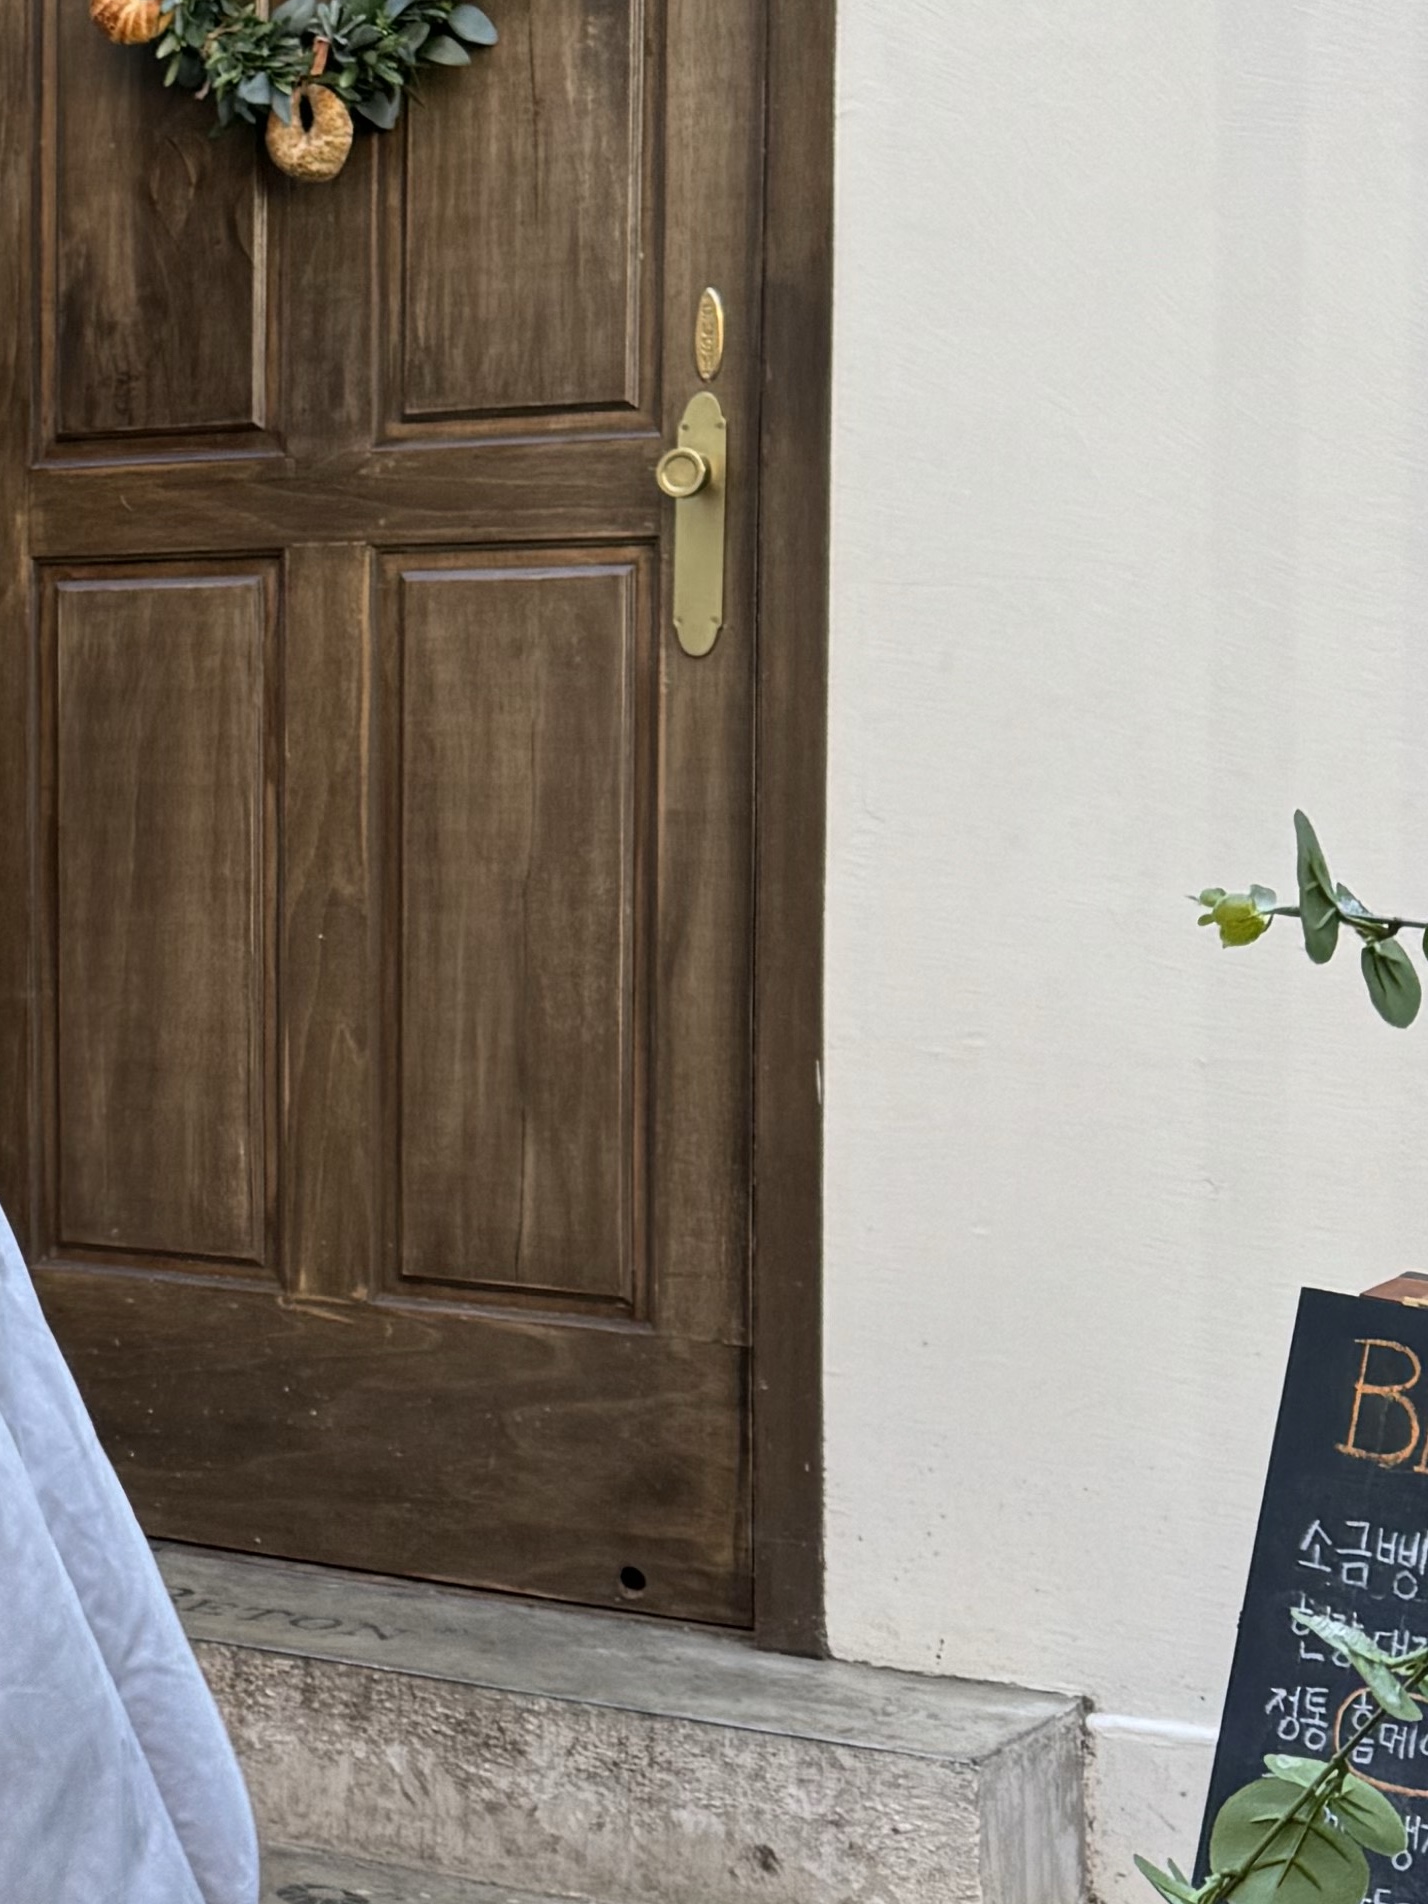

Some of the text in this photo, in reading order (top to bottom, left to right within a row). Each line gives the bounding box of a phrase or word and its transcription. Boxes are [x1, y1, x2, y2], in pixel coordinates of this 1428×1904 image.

[1335, 1338, 1428, 1474] B
[1297, 1520, 1428, 1600] 소금빵
[1265, 1686, 1329, 1750] 정통
